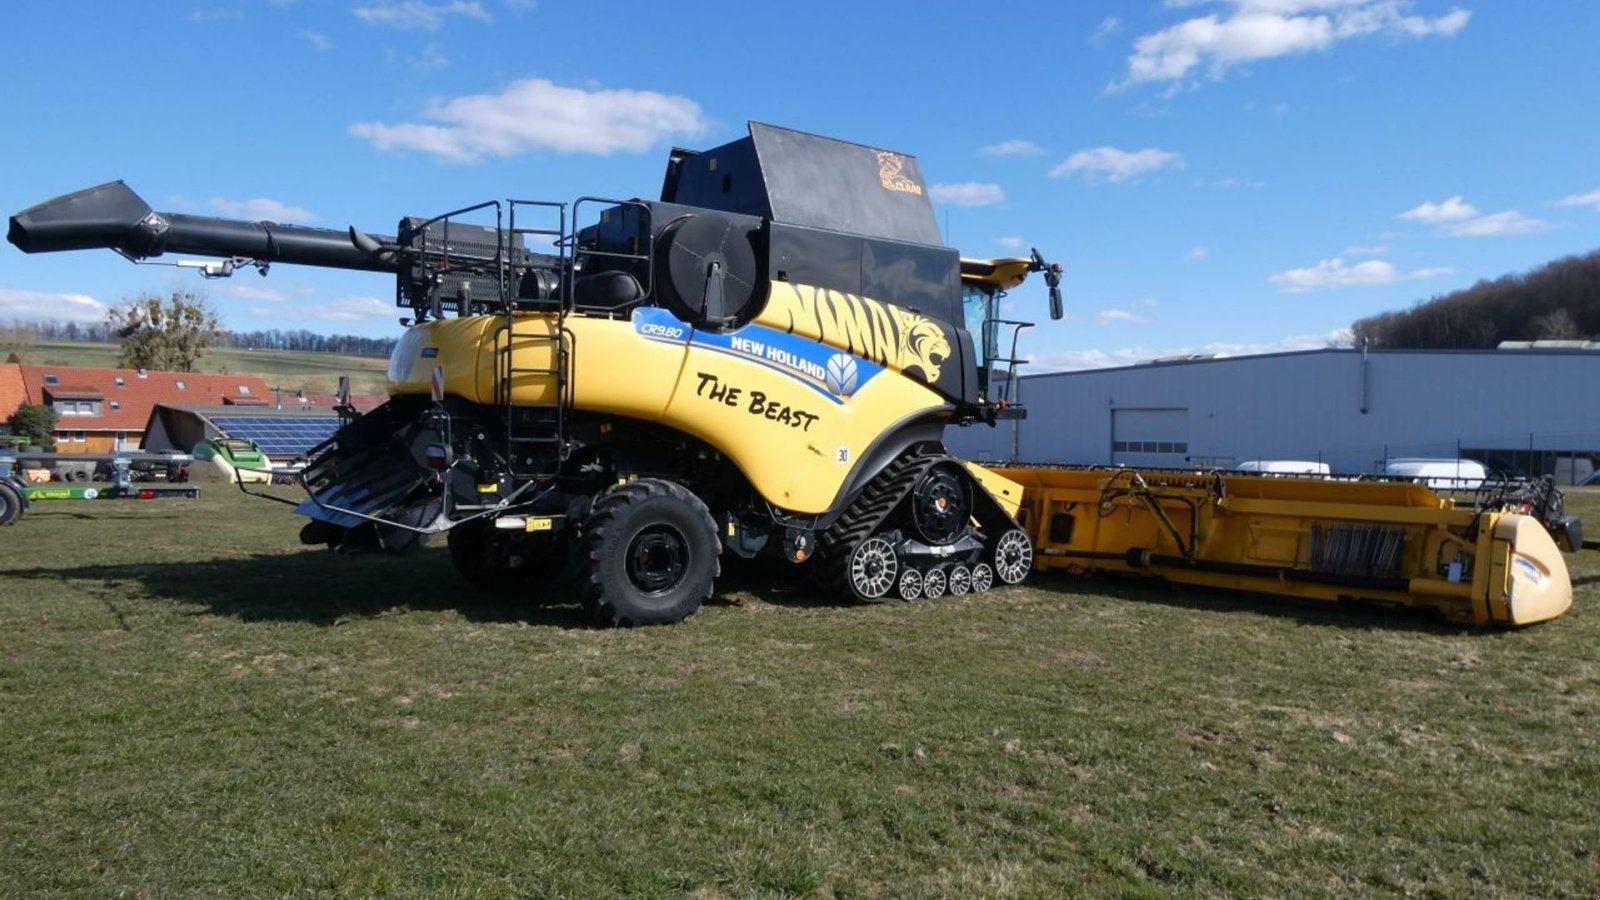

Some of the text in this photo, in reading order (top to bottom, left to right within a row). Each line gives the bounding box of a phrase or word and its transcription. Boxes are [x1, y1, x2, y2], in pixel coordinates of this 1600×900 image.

[731, 336, 826, 380] NEW HOLLAND
[697, 372, 820, 432] THE BEAST
[838, 449, 848, 462] 30
